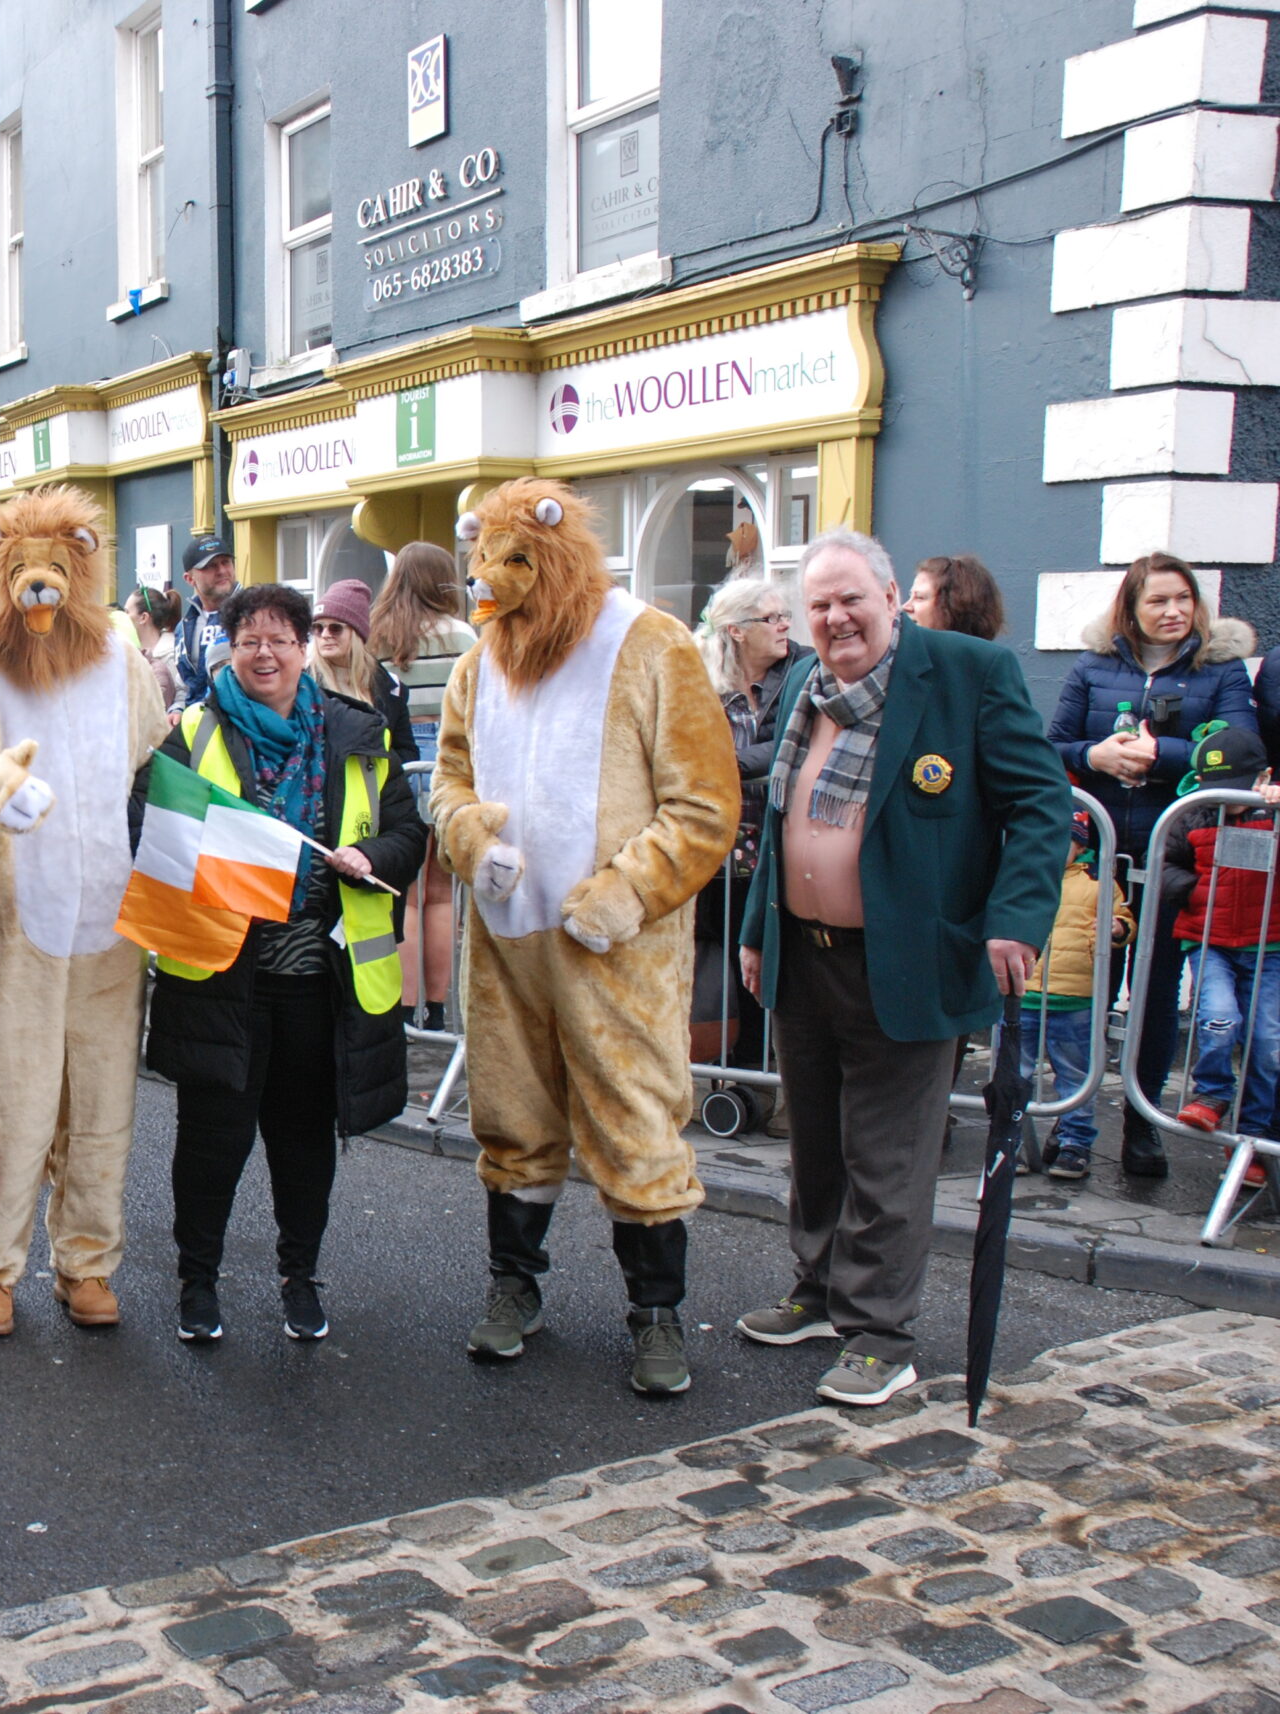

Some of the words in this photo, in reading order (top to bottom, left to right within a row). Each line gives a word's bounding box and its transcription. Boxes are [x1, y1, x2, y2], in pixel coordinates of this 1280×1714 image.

[357, 177, 424, 229] CAHIR
[428, 168, 446, 200] &
[459, 147, 498, 189] CO
[647, 176, 658, 193] C
[364, 208, 496, 270] SOLICITORS
[373, 246, 483, 303] 065-6828383
